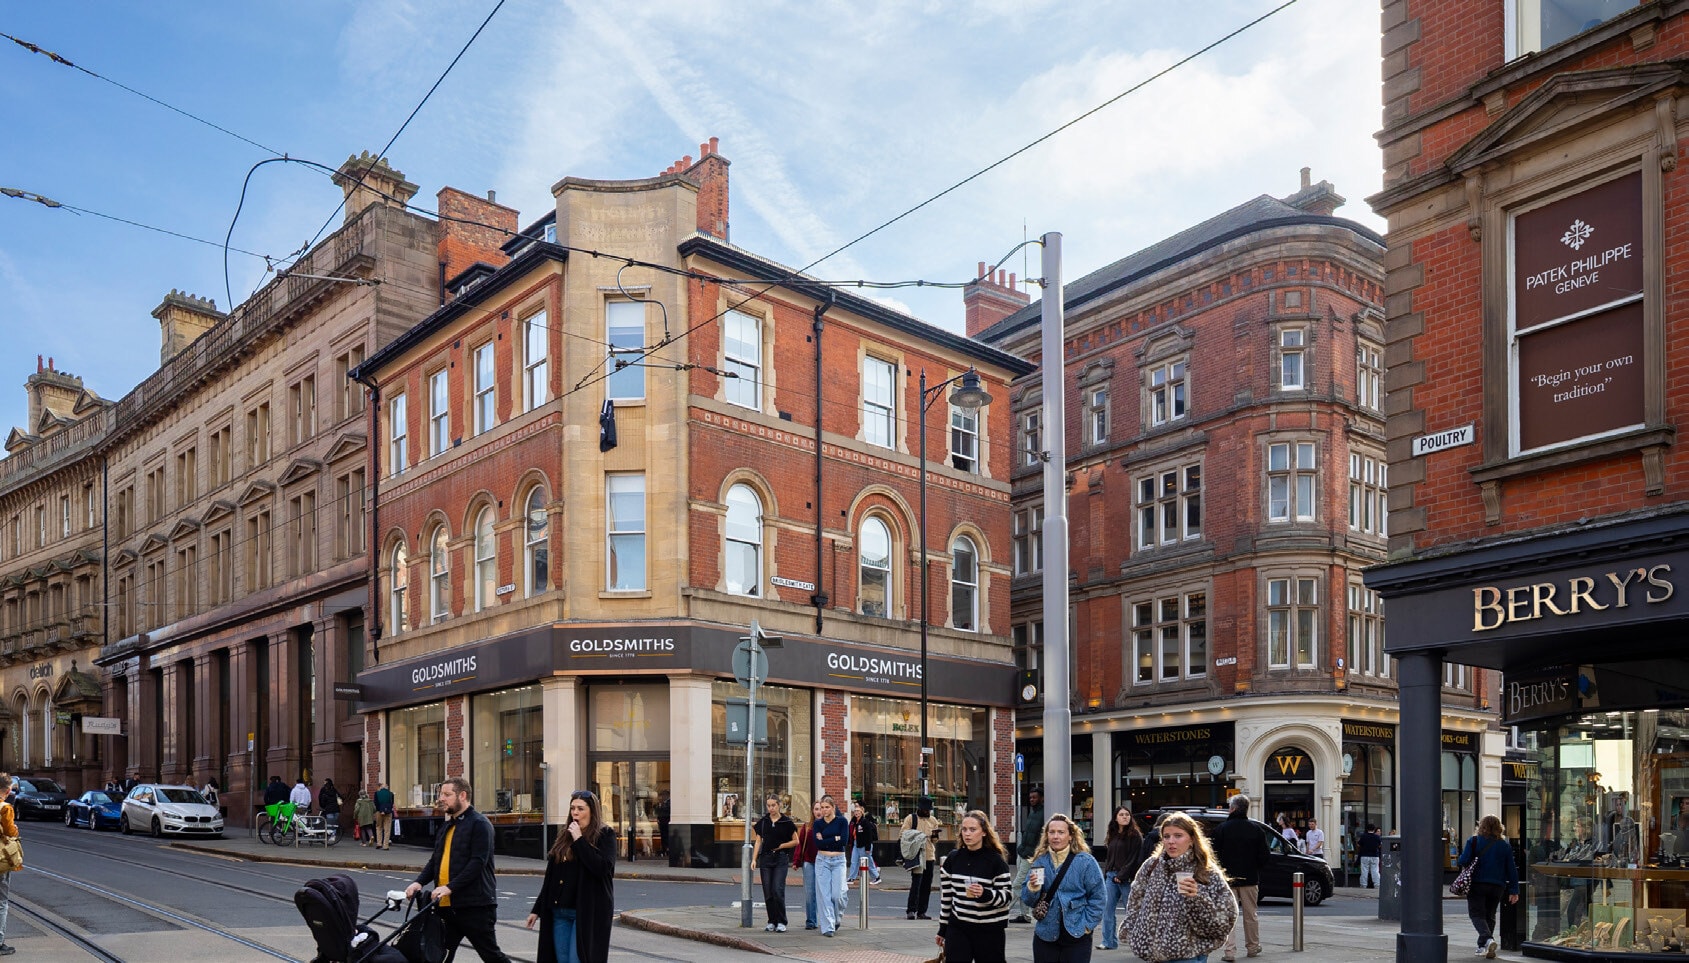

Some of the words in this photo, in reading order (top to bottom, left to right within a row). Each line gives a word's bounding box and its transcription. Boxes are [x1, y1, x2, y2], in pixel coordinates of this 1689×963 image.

[1526, 265, 1568, 290] PATEK
[1571, 243, 1632, 277] PHILIPPE
[1555, 273, 1599, 295] GENEVE
[1530, 370, 1571, 389] “Begin
[1574, 363, 1603, 381] your
[1605, 354, 1633, 370] own
[1553, 377, 1612, 404] tradition”
[1420, 429, 1467, 450] POULTRY
[1472, 564, 1674, 632] BERRY'S
[570, 638, 675, 652] GOLDSMITHS
[412, 655, 477, 684] GOLDSMITHS
[827, 653, 922, 679] GOLDSMITHS
[1510, 677, 1567, 715] BERRY'S
[892, 723, 919, 733] ROLEX
[1136, 728, 1210, 744] WATERSTONES
[1344, 724, 1393, 738] WATERSTONES
[1441, 734, 1453, 743] OKS
[1276, 755, 1304, 775] W
